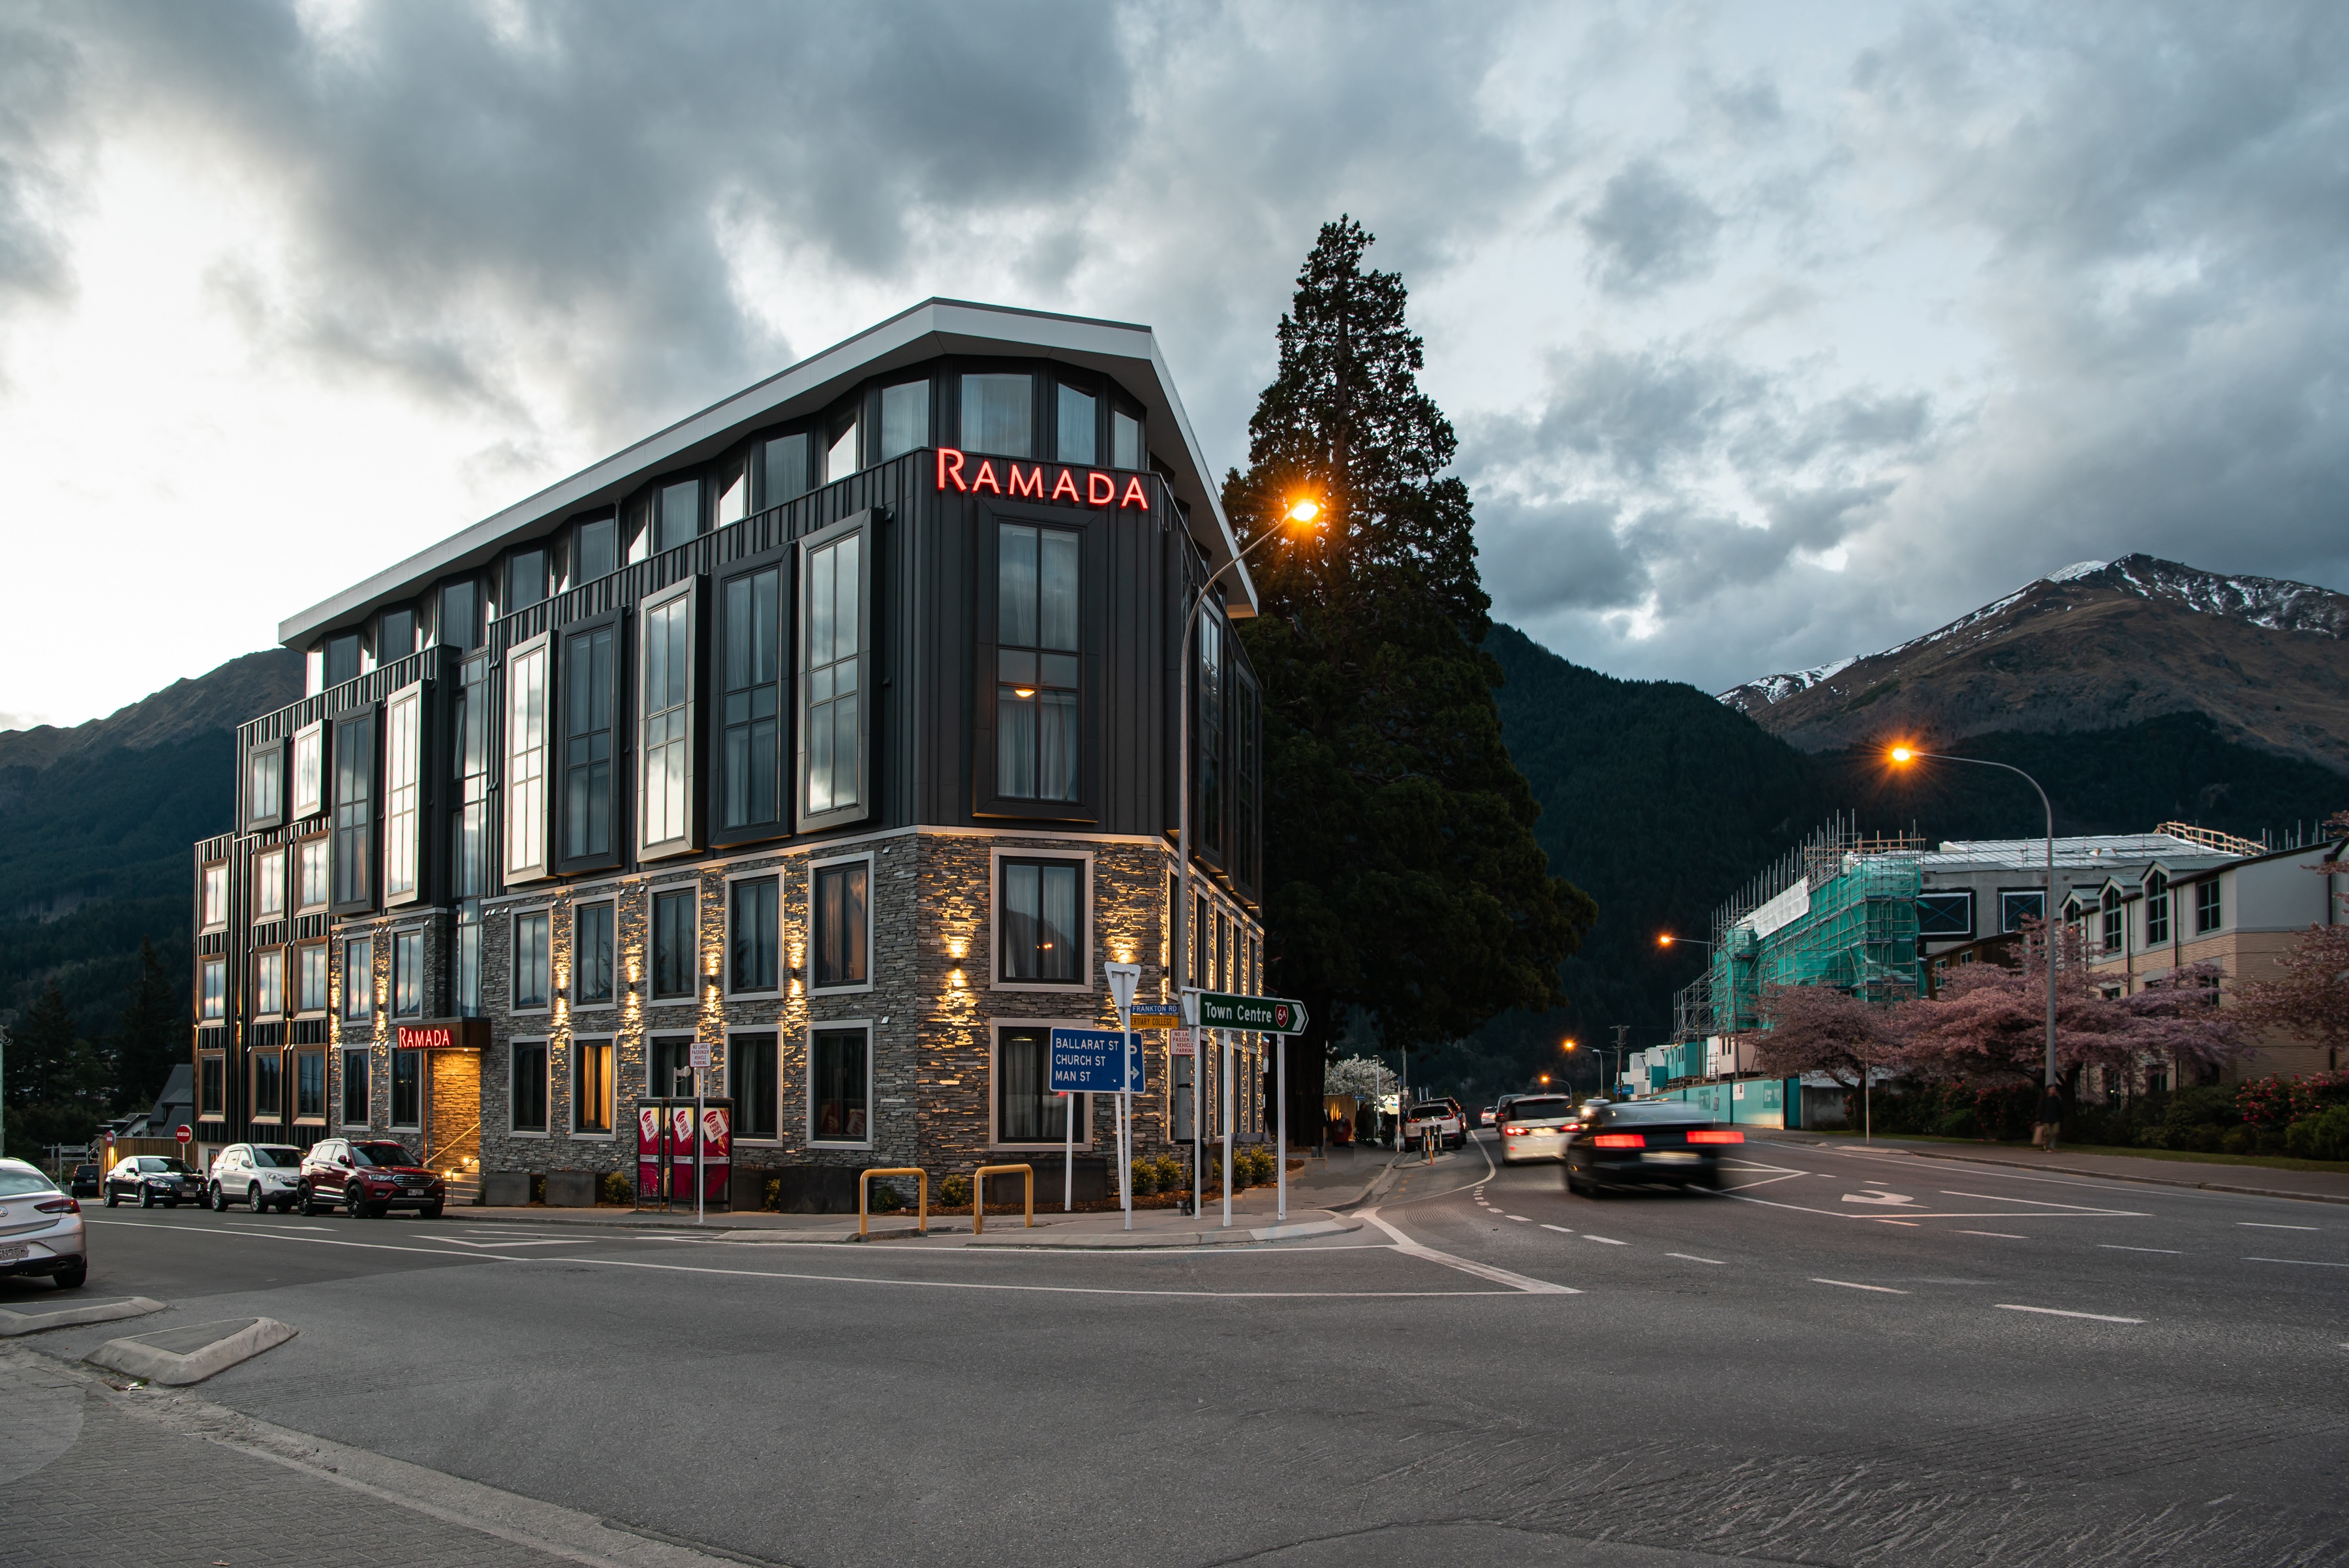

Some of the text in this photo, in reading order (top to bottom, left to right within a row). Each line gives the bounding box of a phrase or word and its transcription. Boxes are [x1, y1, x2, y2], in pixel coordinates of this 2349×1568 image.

[938, 448, 1148, 510] RAMADA
[1205, 1002, 1287, 1023] Town Centre 6A
[399, 1027, 450, 1048] RAMADA
[1056, 1038, 1119, 1051] BALLARAT ST
[1056, 1054, 1106, 1066] CHURCH ST
[1055, 1070, 1090, 1082] MAN ST
[709, 1120, 720, 1130] FREE
[713, 1129, 723, 1137] ZONE
